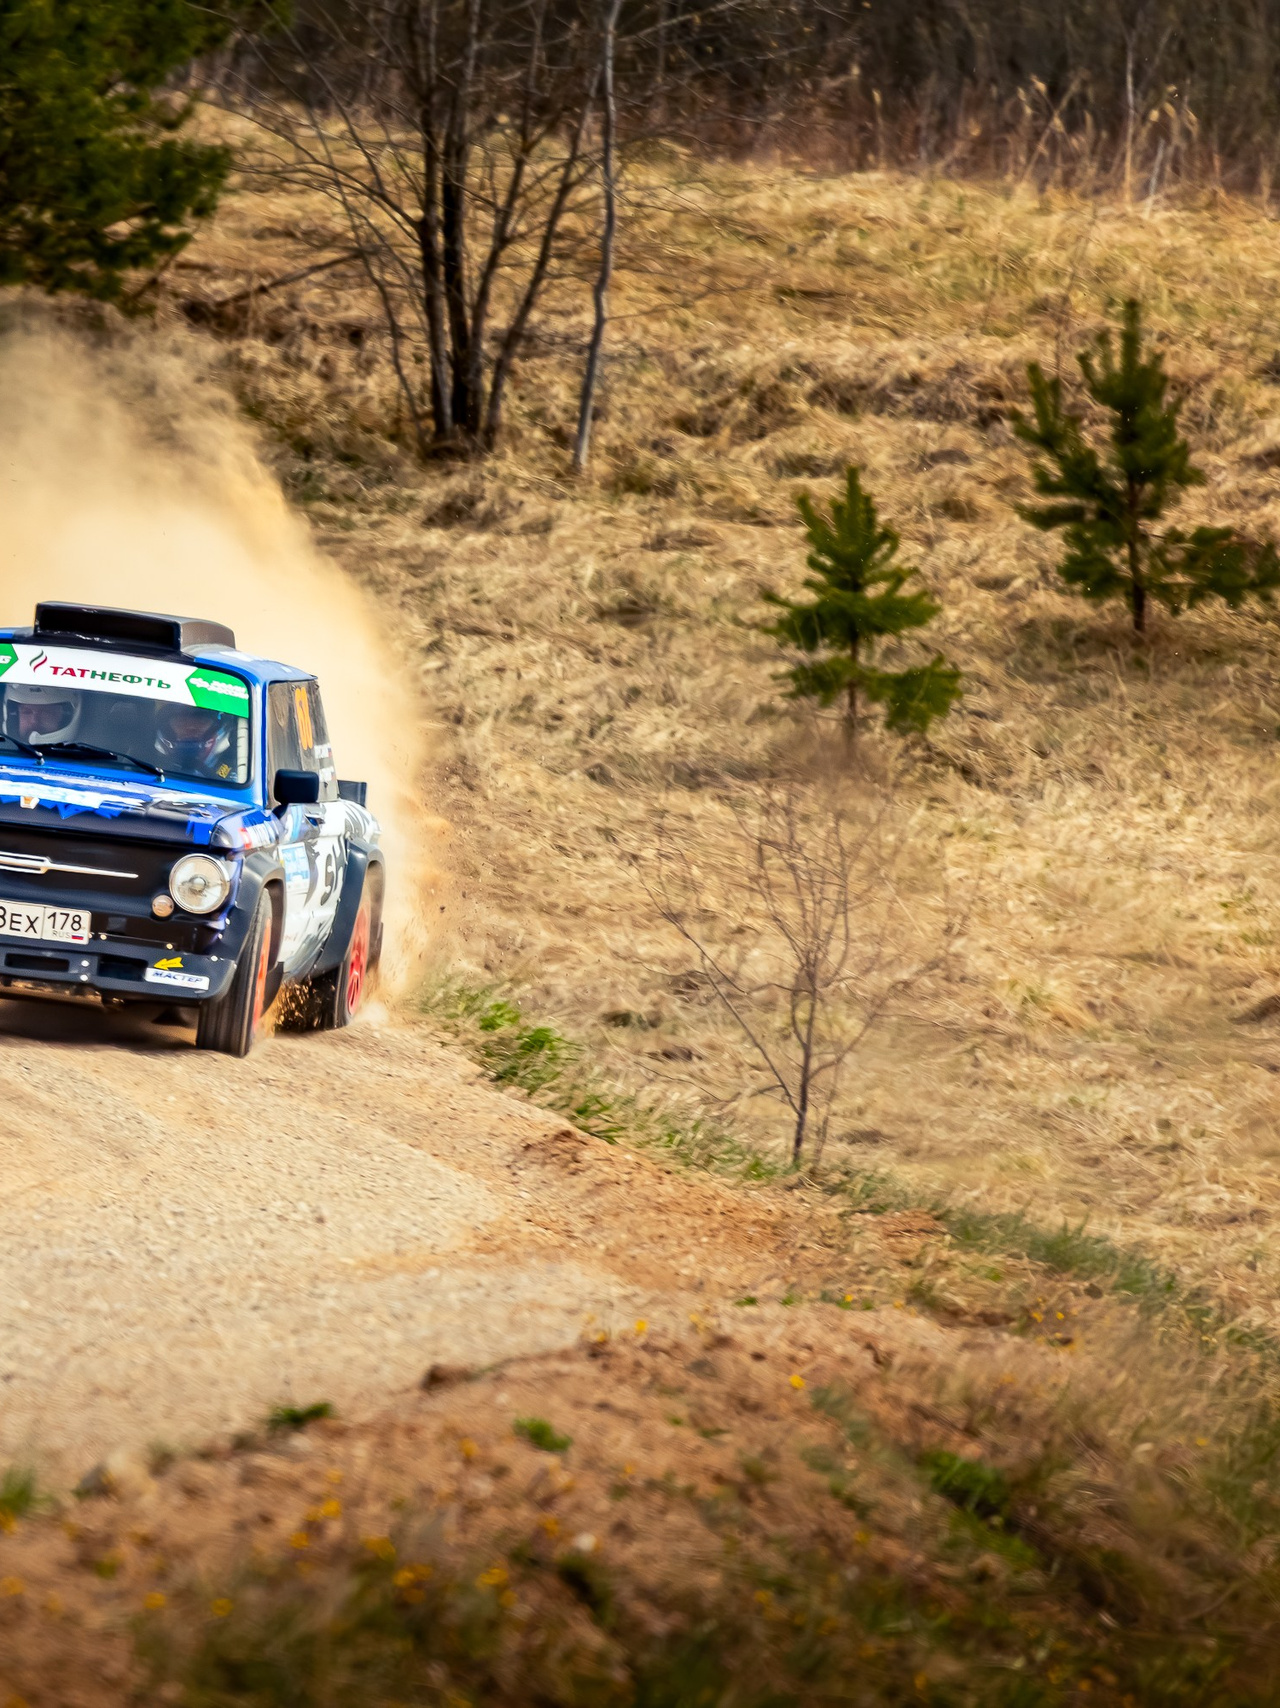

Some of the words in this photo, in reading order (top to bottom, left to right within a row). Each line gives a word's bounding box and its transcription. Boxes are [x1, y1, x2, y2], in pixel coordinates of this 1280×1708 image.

[50, 666, 171, 689] ТАТНЕФТЬ
[47, 911, 82, 932] 178
[51, 929, 71, 938] RUS
[152, 971, 203, 983] МАСТЕР
